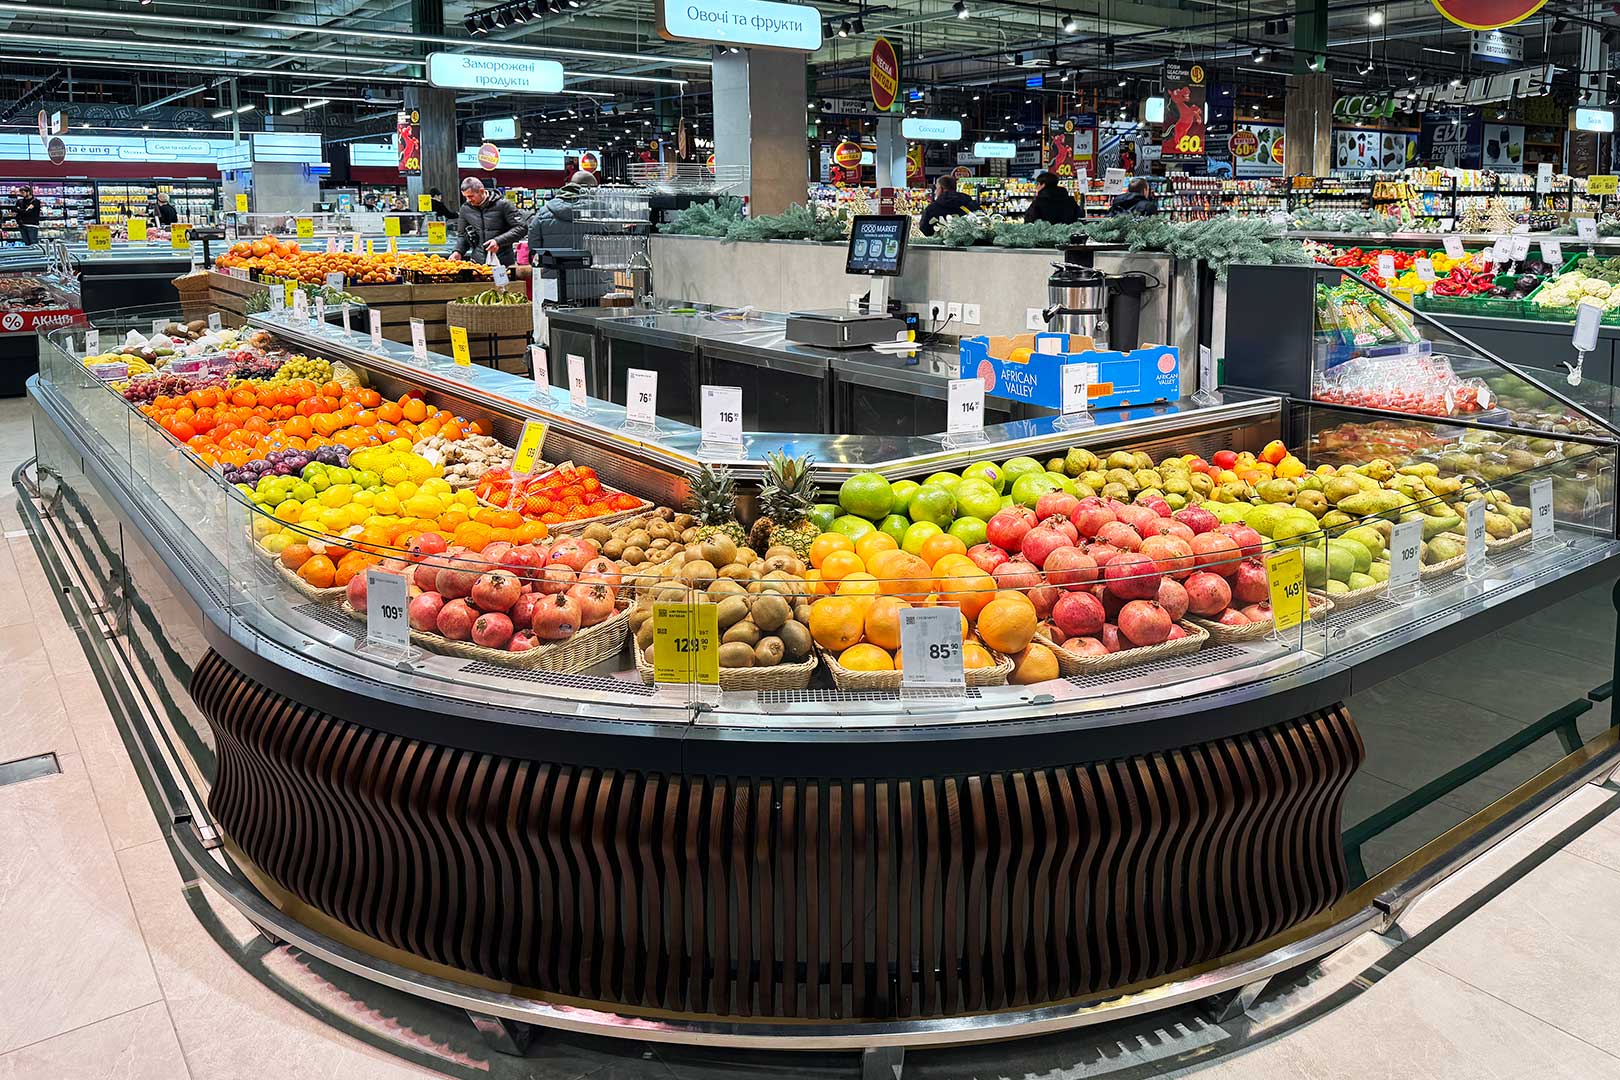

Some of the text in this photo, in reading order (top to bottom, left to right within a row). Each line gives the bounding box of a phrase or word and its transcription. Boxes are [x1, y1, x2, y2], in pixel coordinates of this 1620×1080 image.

[687, 6, 802, 32] Овочі та фрукти
[462, 57, 535, 72] Заморожені
[876, 54, 892, 77] ЧЕСНА
[475, 74, 530, 88] продукти
[873, 66, 894, 91] ВИГОДА
[1431, 145, 1468, 154] POWER
[861, 224, 898, 233] FOOD MARKET
[1001, 368, 1038, 386] AFRICAN
[1155, 373, 1178, 381] AFRICAN
[1005, 381, 1034, 398] VALLEY
[639, 392, 648, 403] 76
[962, 402, 975, 412] 114
[720, 412, 733, 423] 116
[1401, 547, 1415, 560] 109
[1283, 582, 1300, 599] 149
[381, 604, 398, 620] 109
[929, 643, 951, 660] 85
